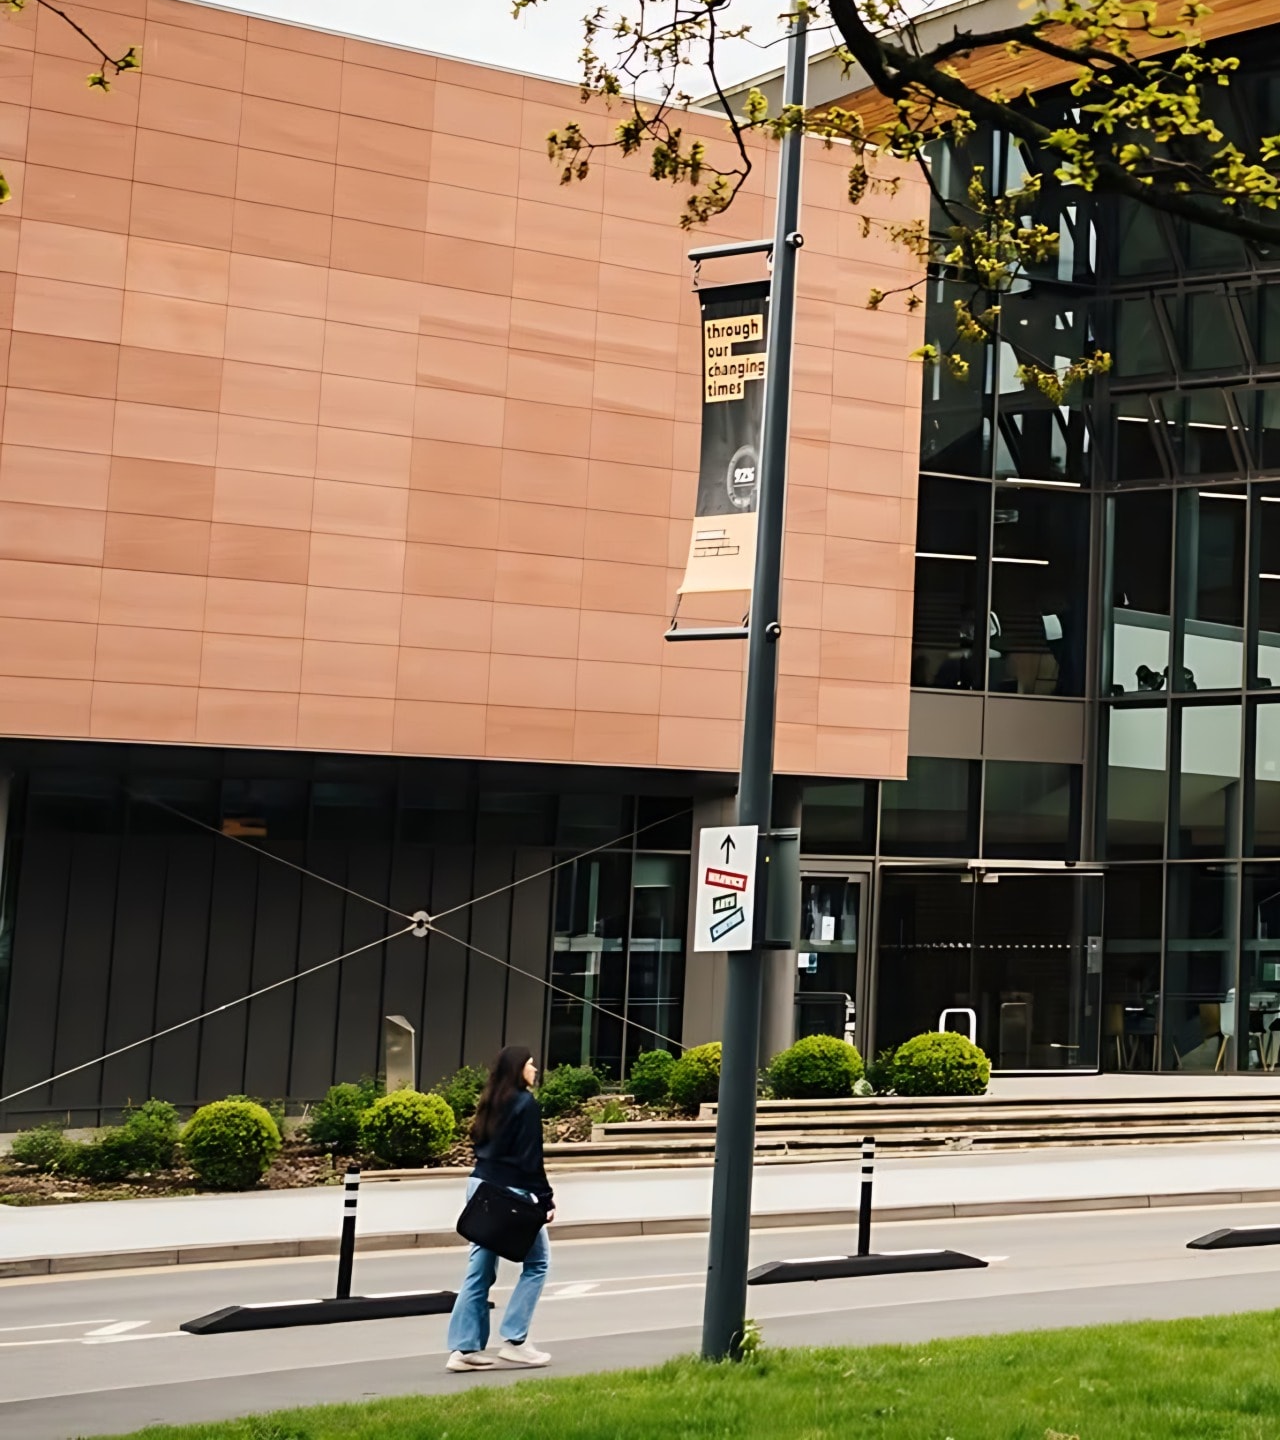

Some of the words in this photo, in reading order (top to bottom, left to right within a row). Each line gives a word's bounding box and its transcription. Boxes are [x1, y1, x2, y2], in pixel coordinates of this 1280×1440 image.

[707, 319, 758, 339] through
[708, 346, 728, 358] our
[708, 358, 765, 378] changing
[708, 380, 741, 397] times
